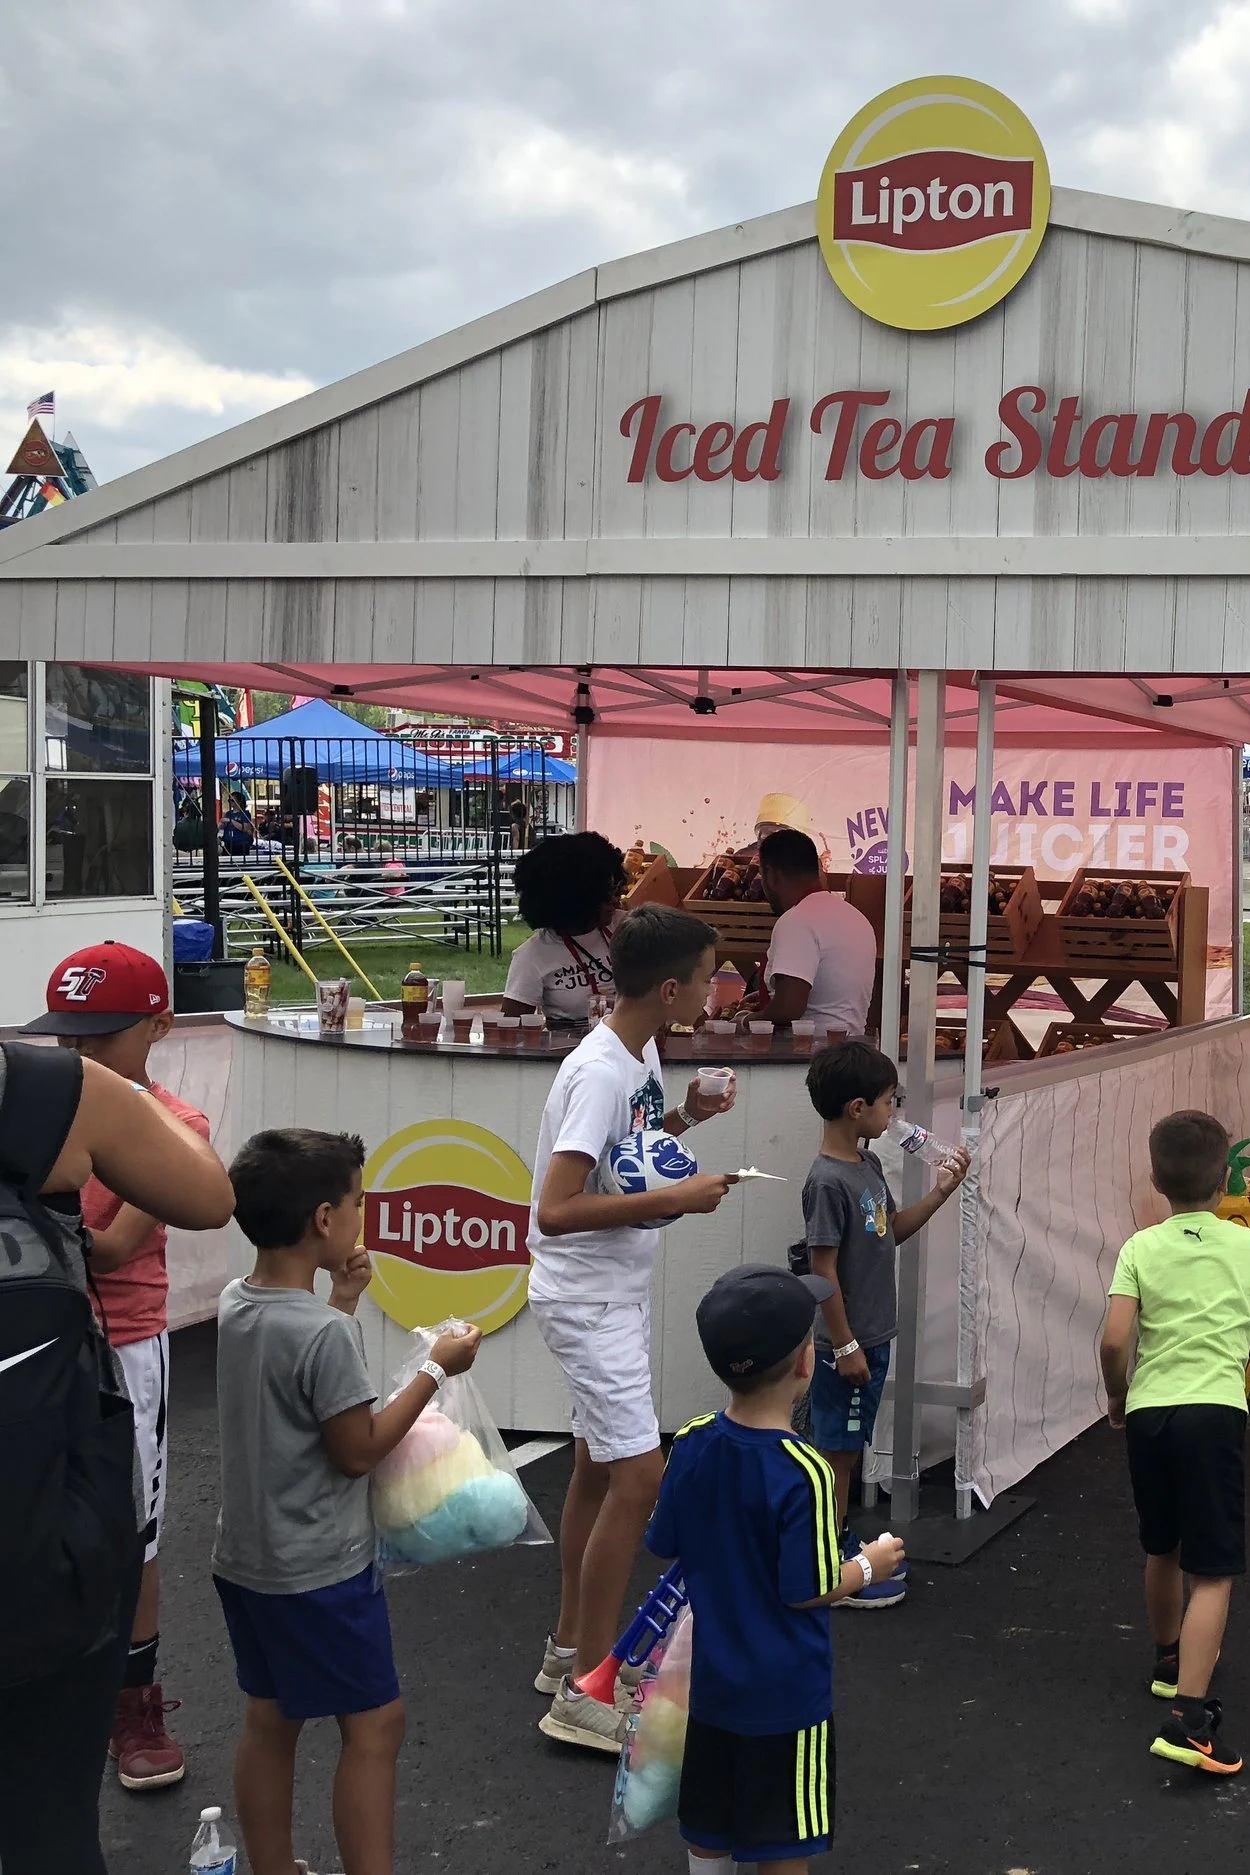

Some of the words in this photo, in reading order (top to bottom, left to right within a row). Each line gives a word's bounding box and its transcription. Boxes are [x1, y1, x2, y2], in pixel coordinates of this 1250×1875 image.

[850, 176, 1015, 235] Lipton
[619, 395, 791, 483] Iced
[809, 389, 956, 482] Tea
[949, 780, 1075, 818] MAKE
[1090, 781, 1185, 818] LIFE
[378, 1200, 517, 1254] Lipton
